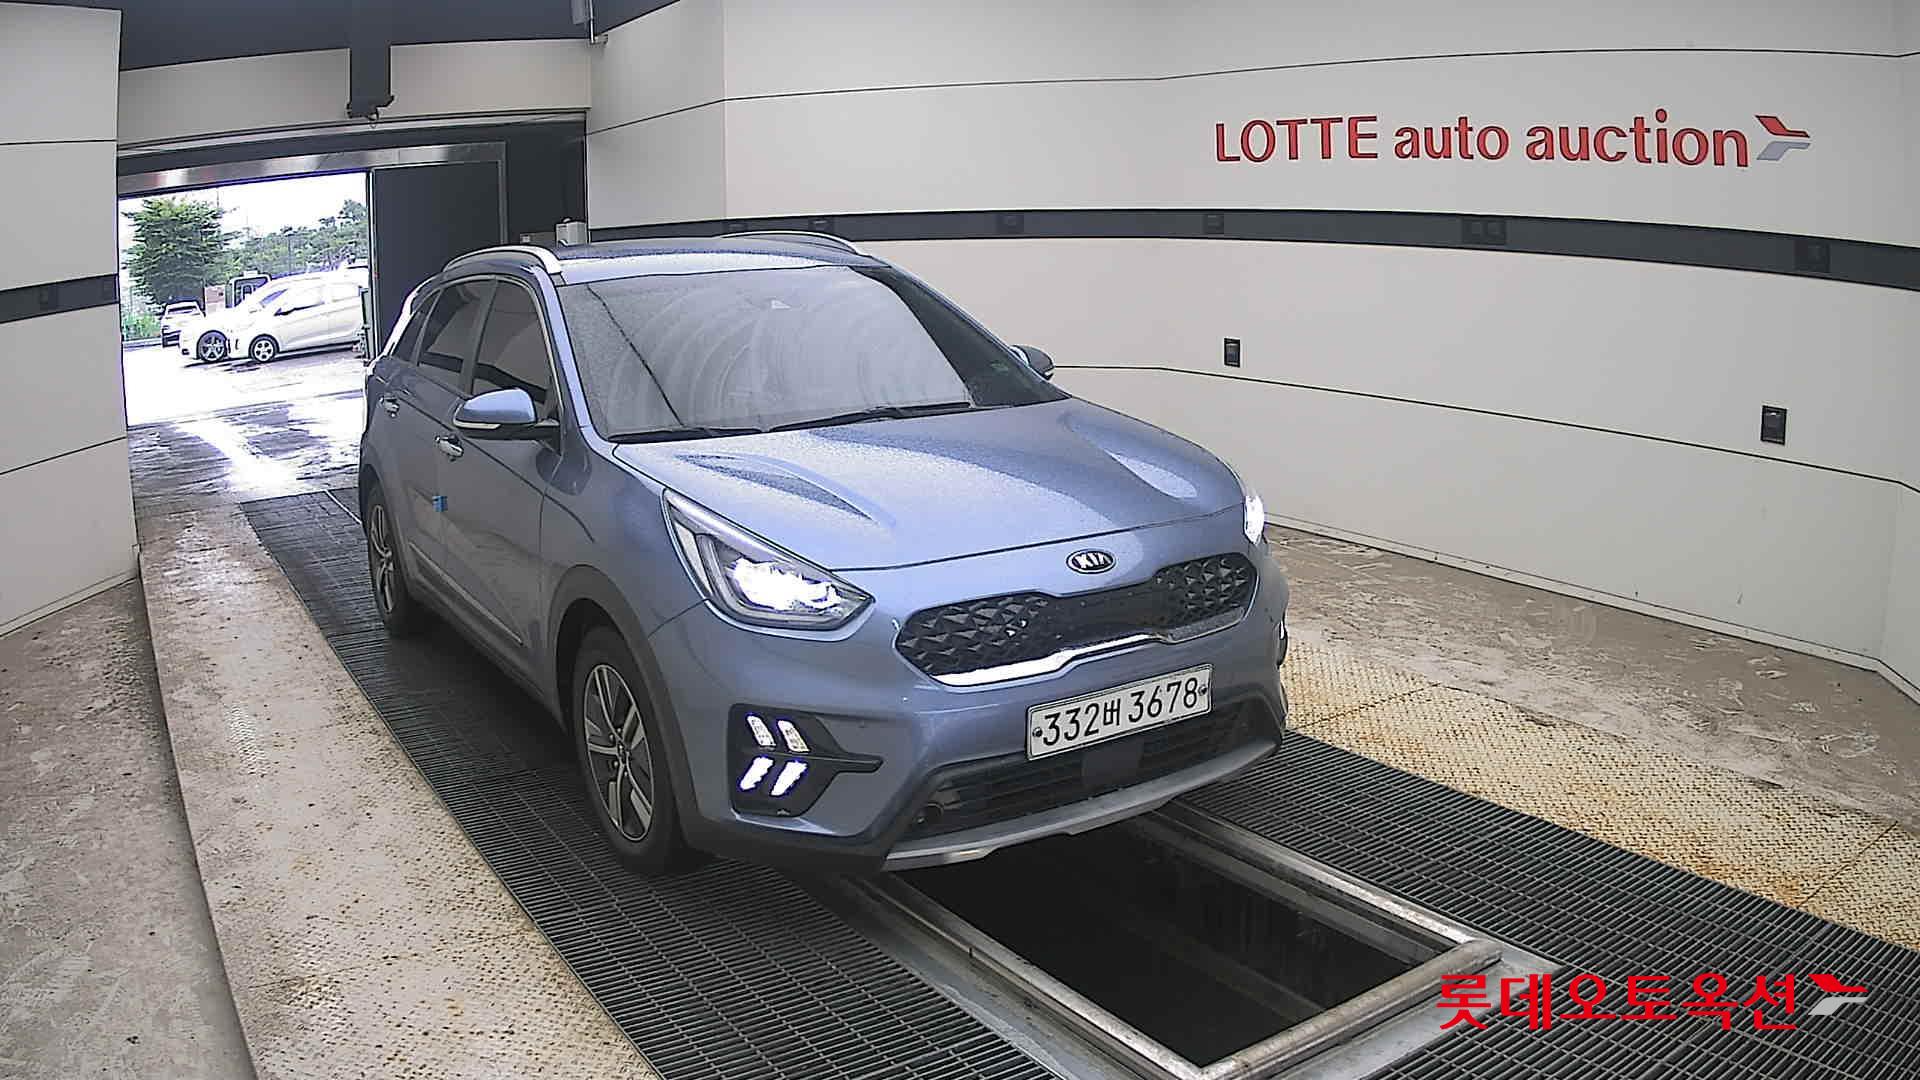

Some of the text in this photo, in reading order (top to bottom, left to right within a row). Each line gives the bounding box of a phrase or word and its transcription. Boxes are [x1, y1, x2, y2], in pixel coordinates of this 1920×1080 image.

[1215, 108, 1750, 168] LOTTE auto auction
[1073, 552, 1112, 570] KIA
[1042, 677, 1199, 746] 332버 3678
